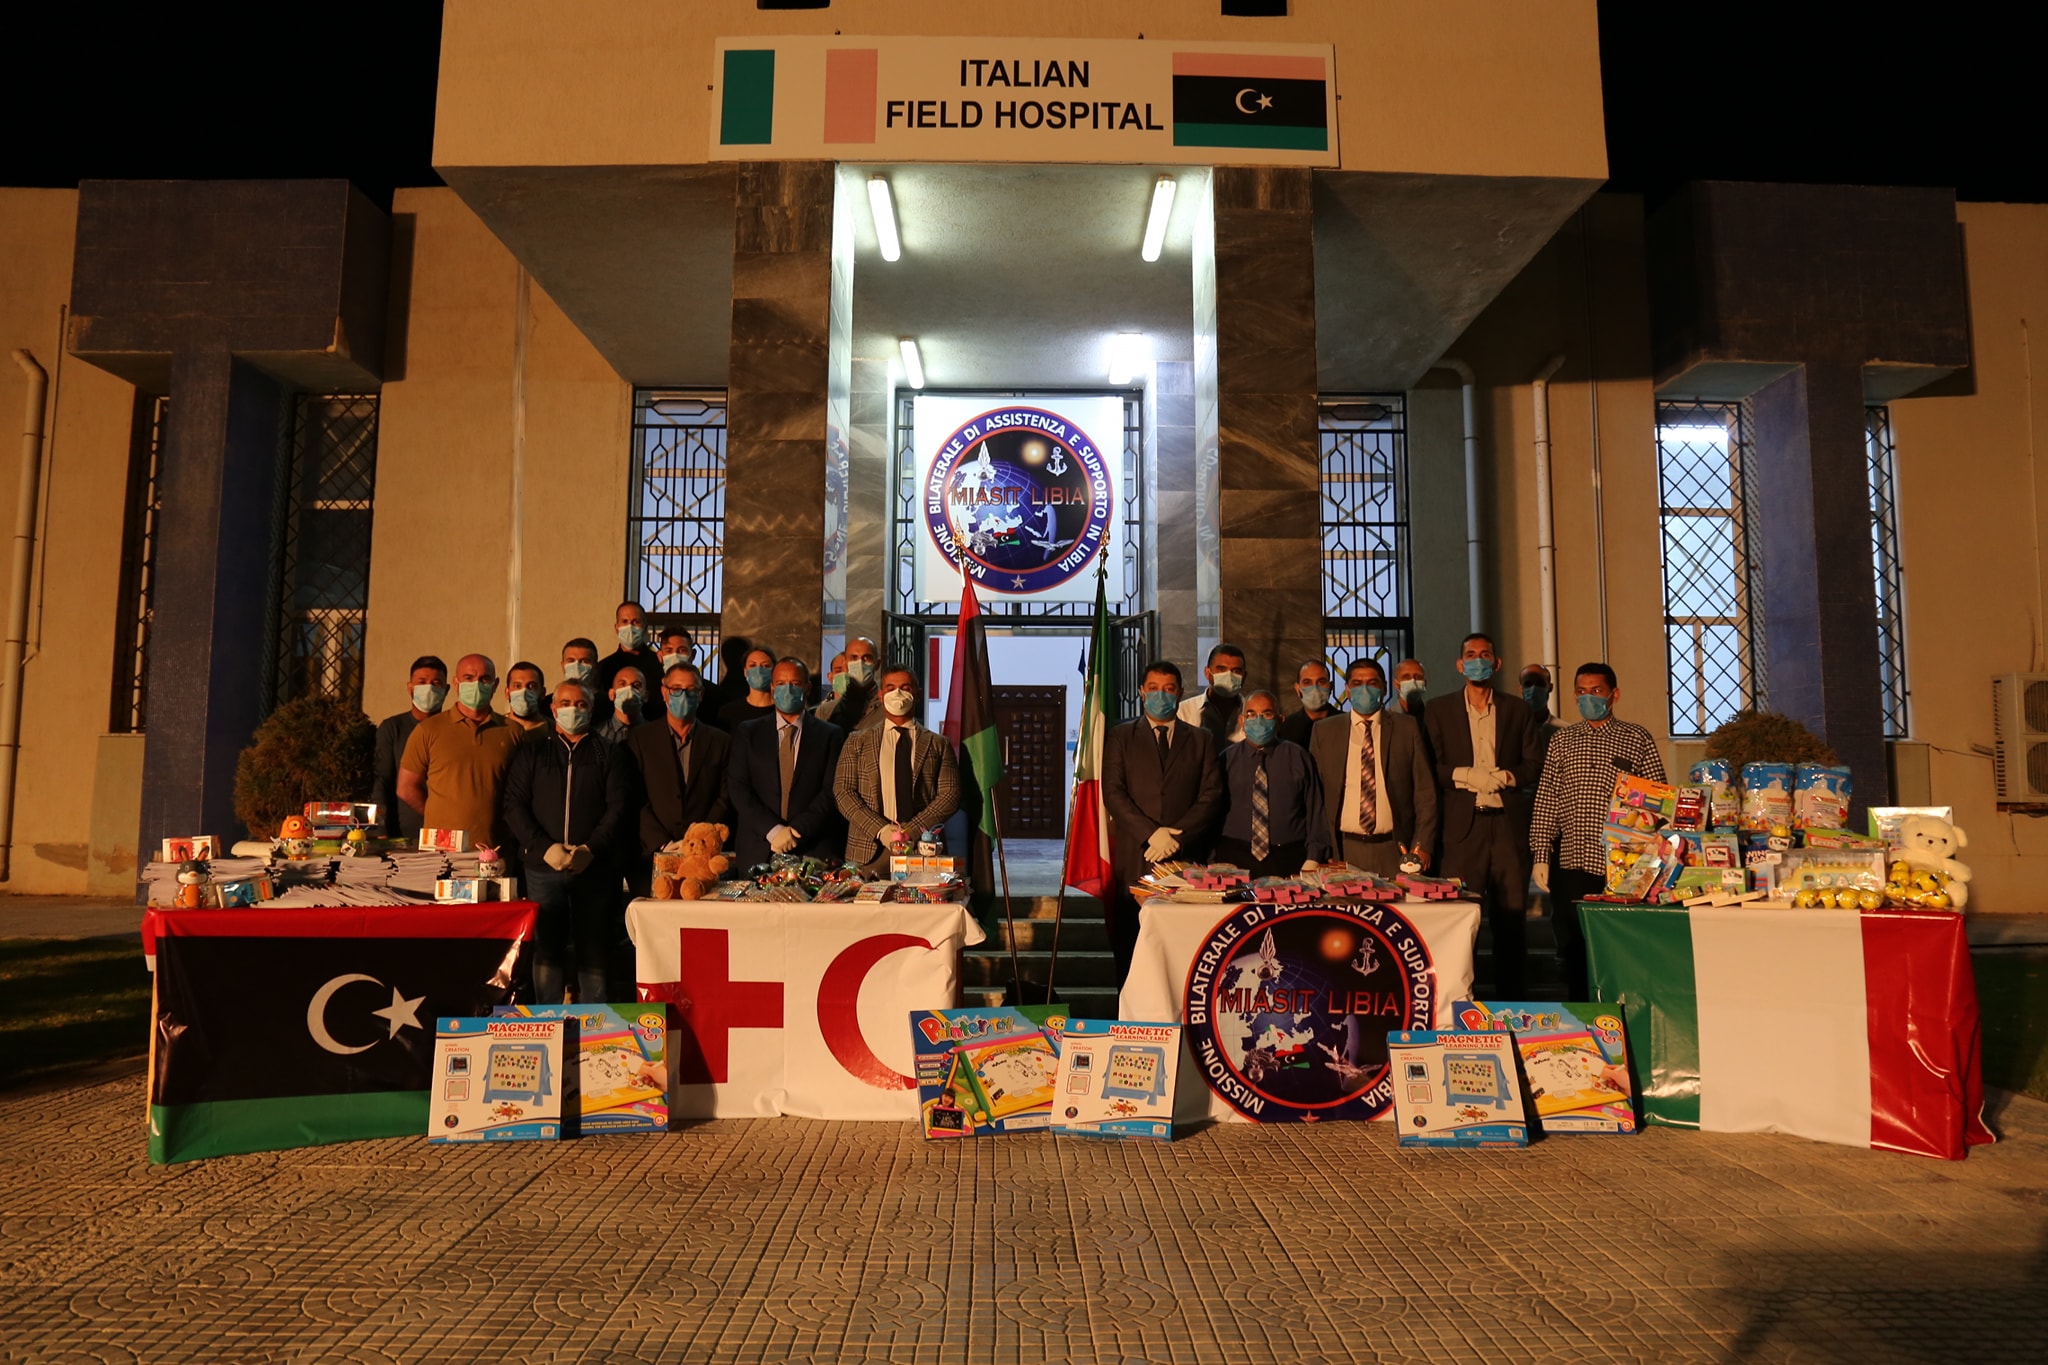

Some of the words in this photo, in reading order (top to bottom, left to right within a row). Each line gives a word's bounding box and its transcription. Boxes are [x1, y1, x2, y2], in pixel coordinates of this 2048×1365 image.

[960, 59, 1090, 88] ITALIAN
[885, 101, 983, 129] FIELD
[995, 102, 1164, 131] HOSPITAL
[963, 424, 981, 442] DI
[985, 413, 1067, 438] ASSISTENZA
[1068, 434, 1081, 446] E
[929, 438, 964, 514] BILATERALE
[1078, 445, 1107, 519] SUPPORTO
[951, 487, 1021, 506] MIASIT
[1031, 487, 1086, 505] LIBIA
[1086, 524, 1102, 541] IN
[1057, 543, 1091, 573] LIBIA
[1243, 906, 1266, 927] DI
[1385, 922, 1402, 938] E
[1190, 922, 1241, 1024] BILATERALE
[1219, 987, 1316, 1014] MIASIT
[1327, 991, 1400, 1016] LIBIA
[488, 1023, 555, 1033] MAGNETIC
[919, 1018, 987, 1042] Painter
[1110, 1026, 1172, 1036] MAGNETIC
[1437, 1035, 1502, 1044] MAGNETIC
[1200, 1037, 1265, 1115] MISSIONE
[1361, 1074, 1391, 1108] BIA
